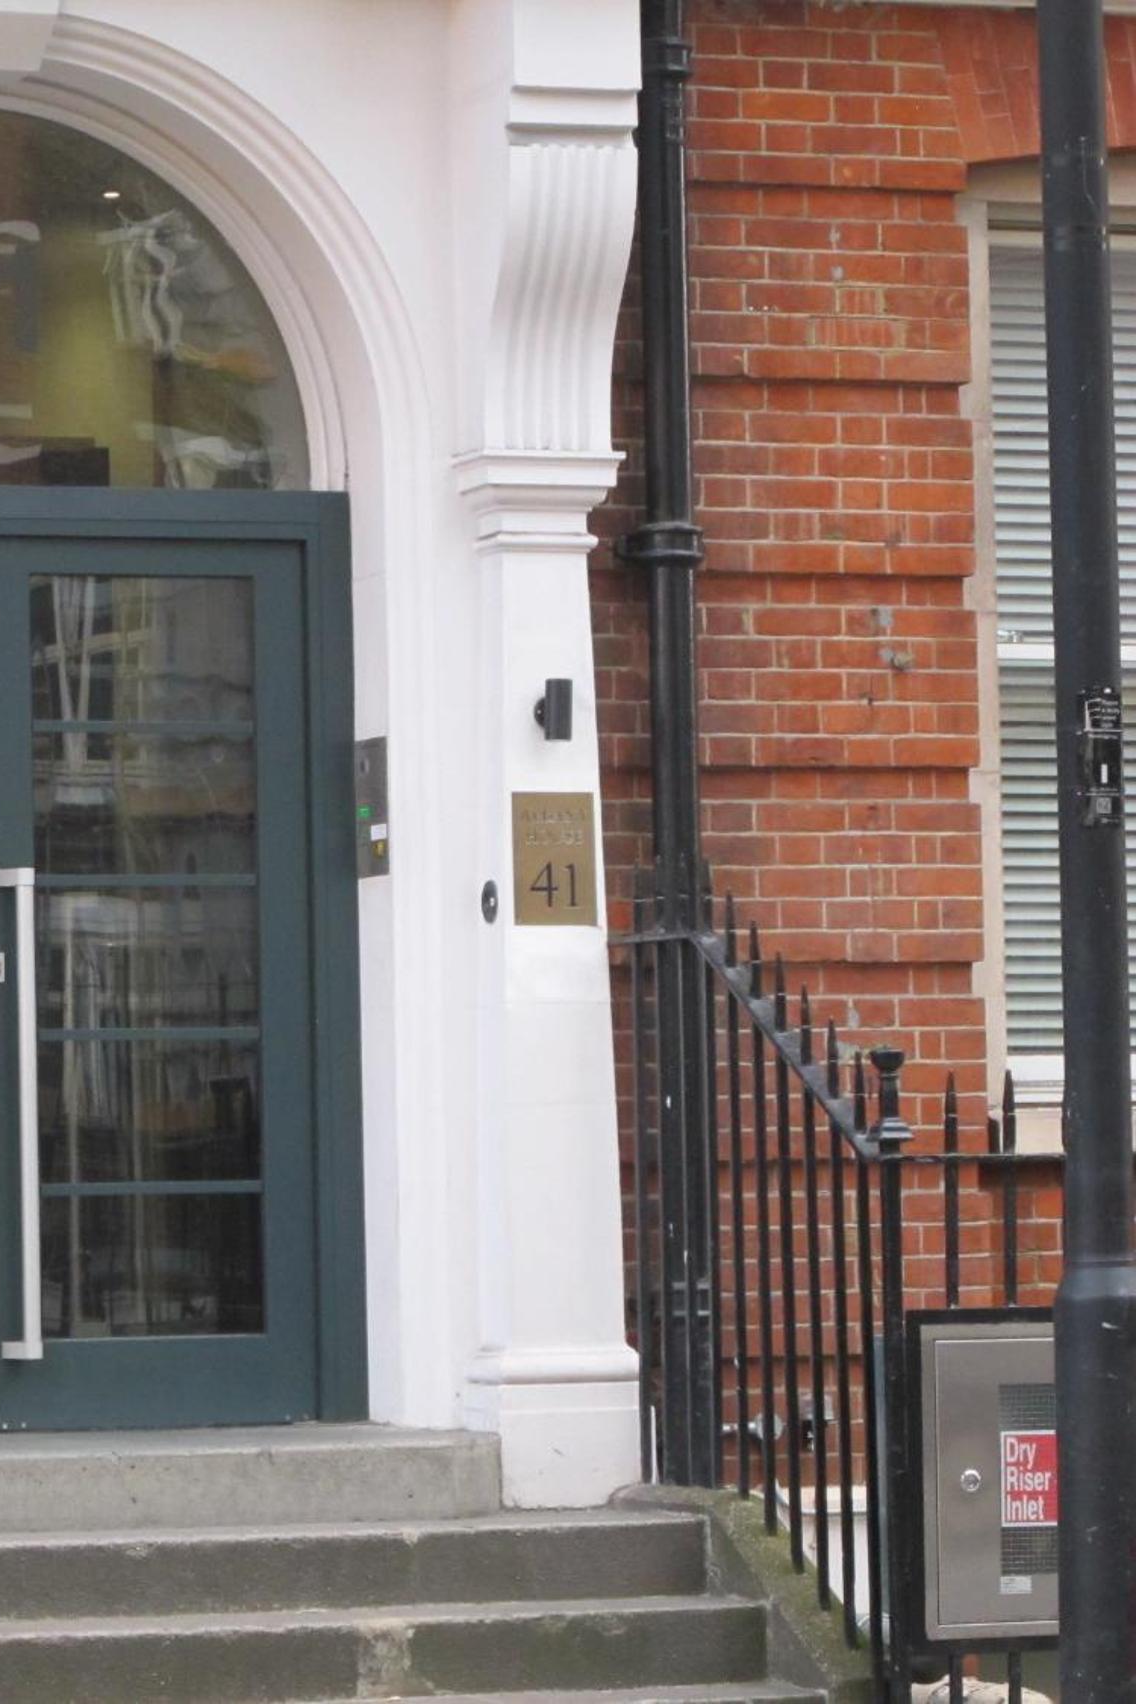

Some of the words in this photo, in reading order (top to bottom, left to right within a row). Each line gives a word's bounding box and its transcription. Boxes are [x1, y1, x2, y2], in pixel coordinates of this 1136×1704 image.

[529, 861, 579, 908] 41
[1005, 1436, 1037, 1470] Dry
[1006, 1465, 1053, 1492] Riser
[1006, 1494, 1046, 1521] Inlet
